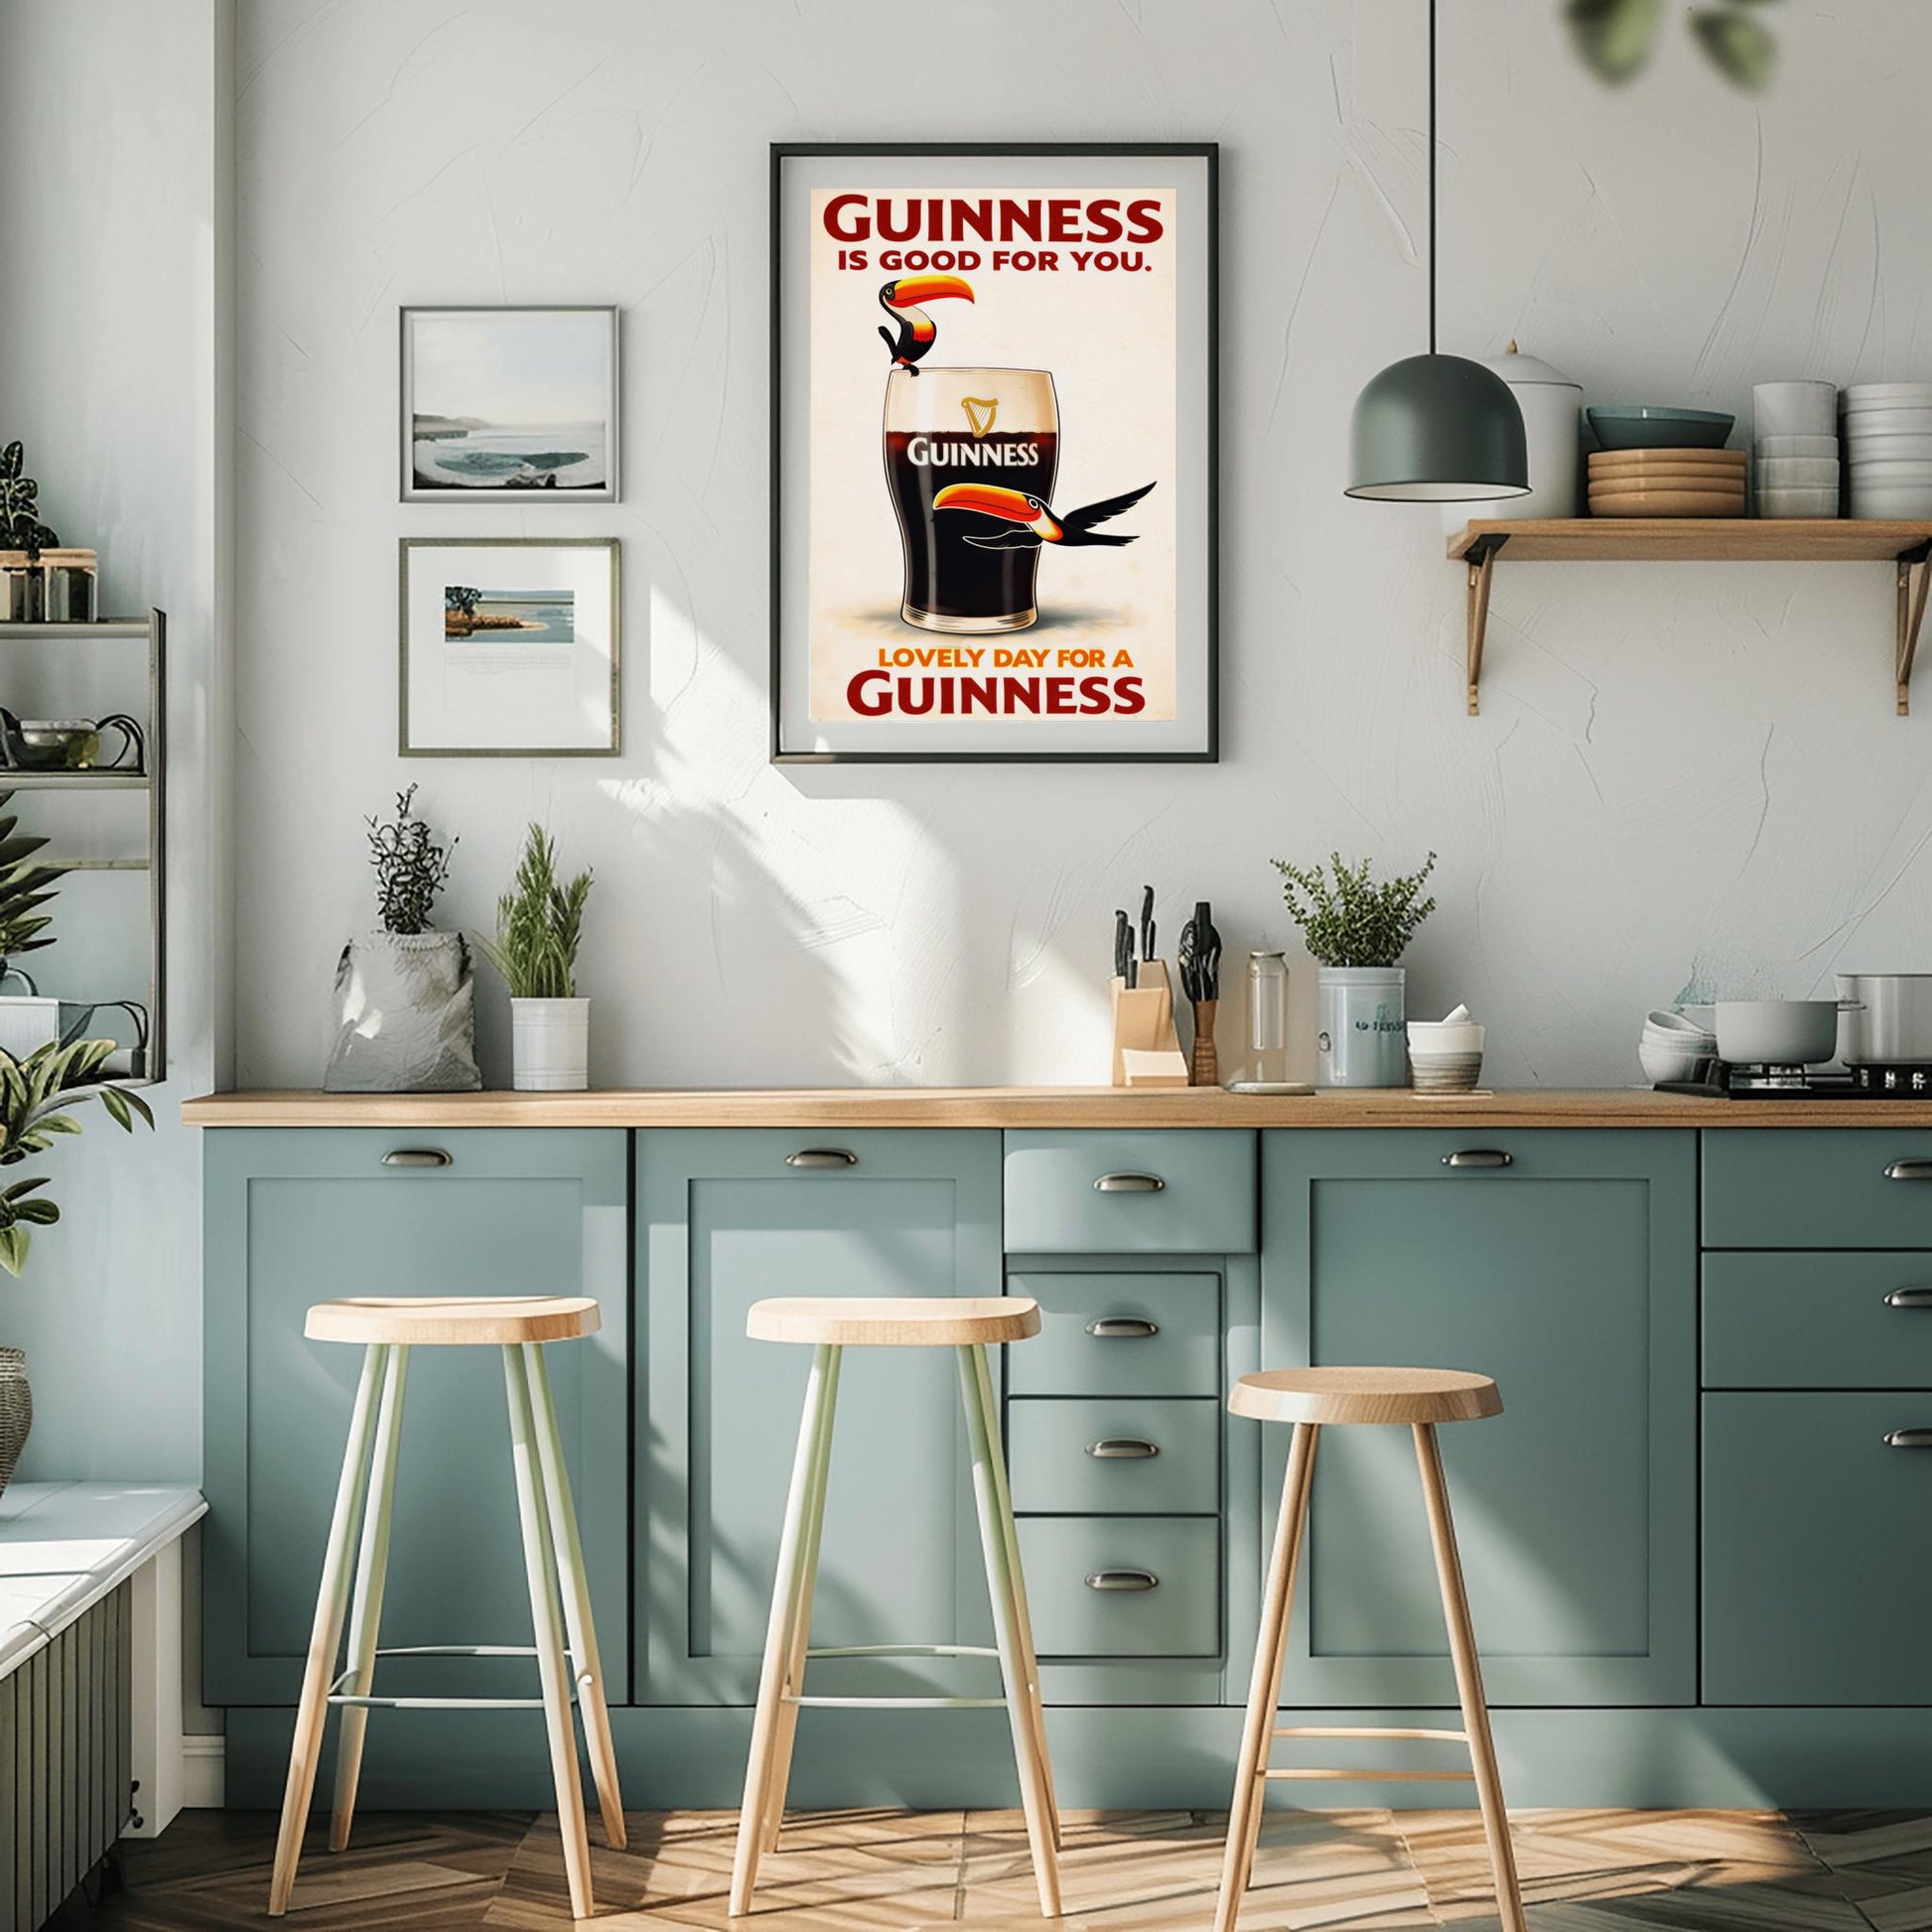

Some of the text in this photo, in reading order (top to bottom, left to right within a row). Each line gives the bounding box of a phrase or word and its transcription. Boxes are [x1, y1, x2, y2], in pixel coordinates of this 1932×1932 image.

[823, 194, 1164, 244] GUINNESS
[838, 249, 1153, 272] IS GOOD FOR YOU.
[906, 436, 1039, 467] GUINNESS
[878, 647, 1135, 668] LOVELY DAY FOR A
[846, 669, 1146, 717] GUINNESS
